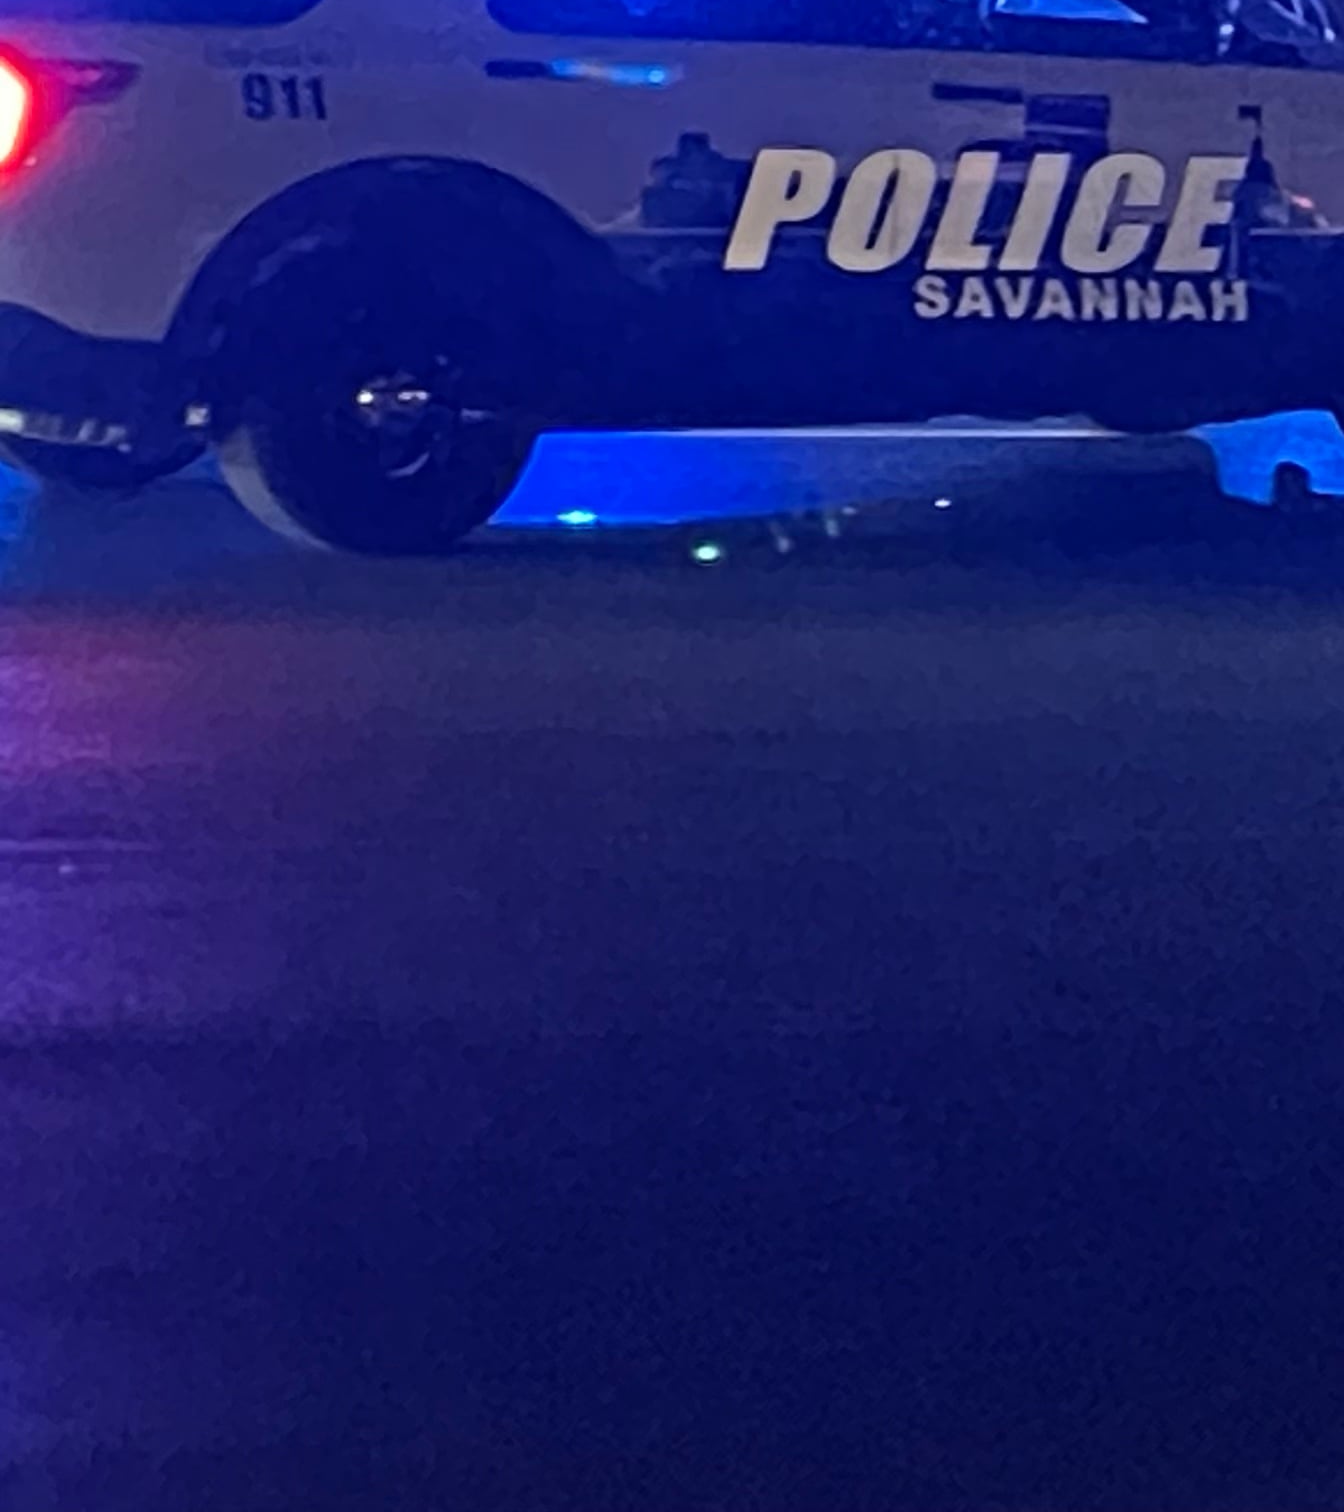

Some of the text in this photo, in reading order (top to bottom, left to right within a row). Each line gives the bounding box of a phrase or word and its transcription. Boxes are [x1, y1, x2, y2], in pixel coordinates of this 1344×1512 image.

[242, 73, 328, 120] 911
[724, 148, 1247, 273] POLICE
[913, 275, 1248, 321] SAVANNAH
